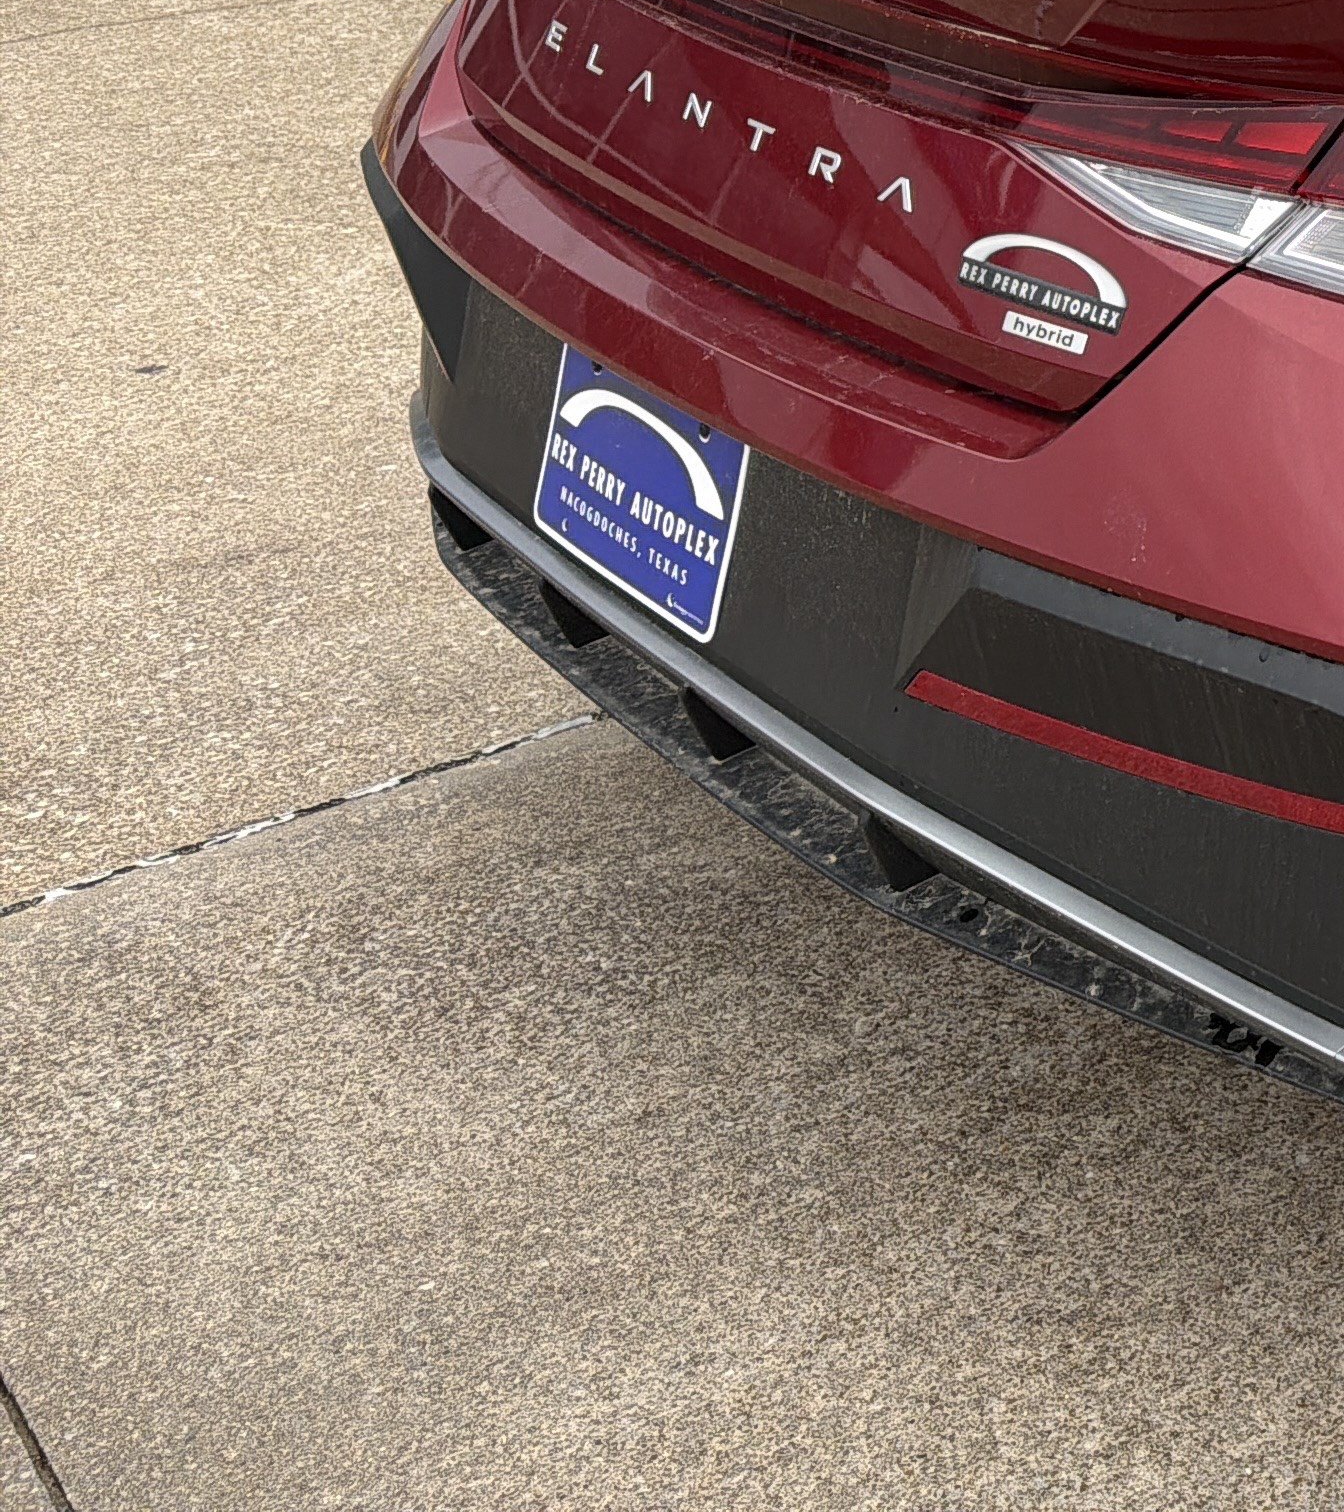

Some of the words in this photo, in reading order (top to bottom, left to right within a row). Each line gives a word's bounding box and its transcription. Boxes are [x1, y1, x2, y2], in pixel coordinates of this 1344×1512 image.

[544, 19, 914, 214] ELANTRA
[959, 261, 989, 286] REX
[992, 273, 1039, 302] PERRY
[1040, 289, 1121, 329] AUTOPLEX
[1012, 316, 1076, 348] hybrid
[551, 432, 578, 472] REX
[579, 454, 627, 507] PERRY
[629, 491, 720, 566] AUTOPLEX
[559, 485, 642, 559] NACOGDOCHES,
[648, 547, 689, 586] TEXAS
